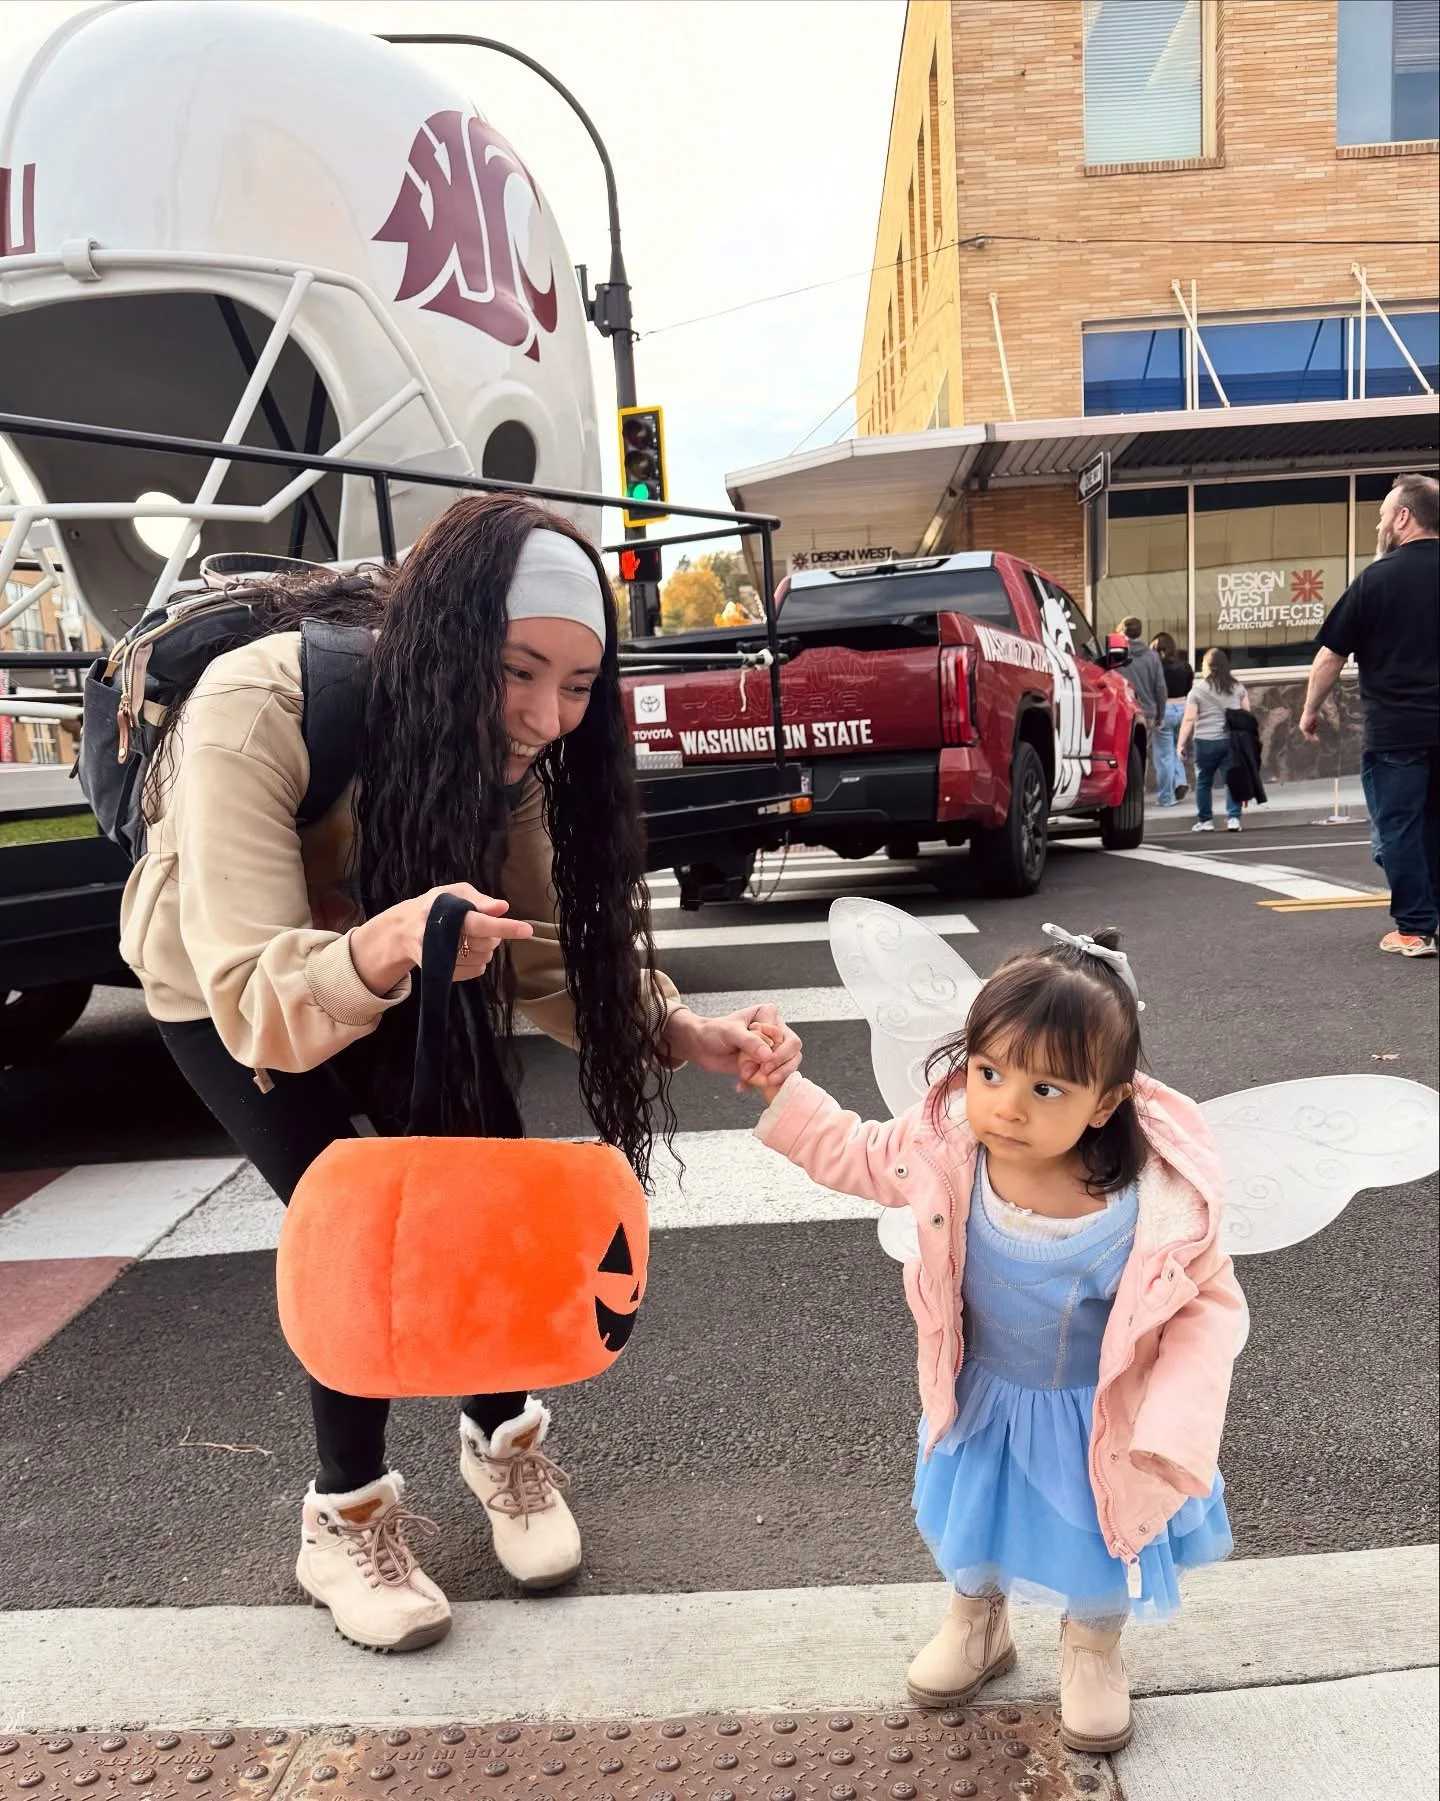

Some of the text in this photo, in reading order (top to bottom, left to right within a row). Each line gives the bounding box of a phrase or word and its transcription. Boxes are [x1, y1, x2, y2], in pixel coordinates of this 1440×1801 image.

[811, 546, 893, 563] DESIGN WEST
[1217, 570, 1285, 591] DESIGN
[1218, 588, 1271, 607] WEST
[1217, 602, 1325, 623] ARCHITECTS
[1217, 620, 1275, 631] ARCHITECTURE
[632, 728, 674, 741] TOYOTA
[811, 719, 874, 747] STATE
